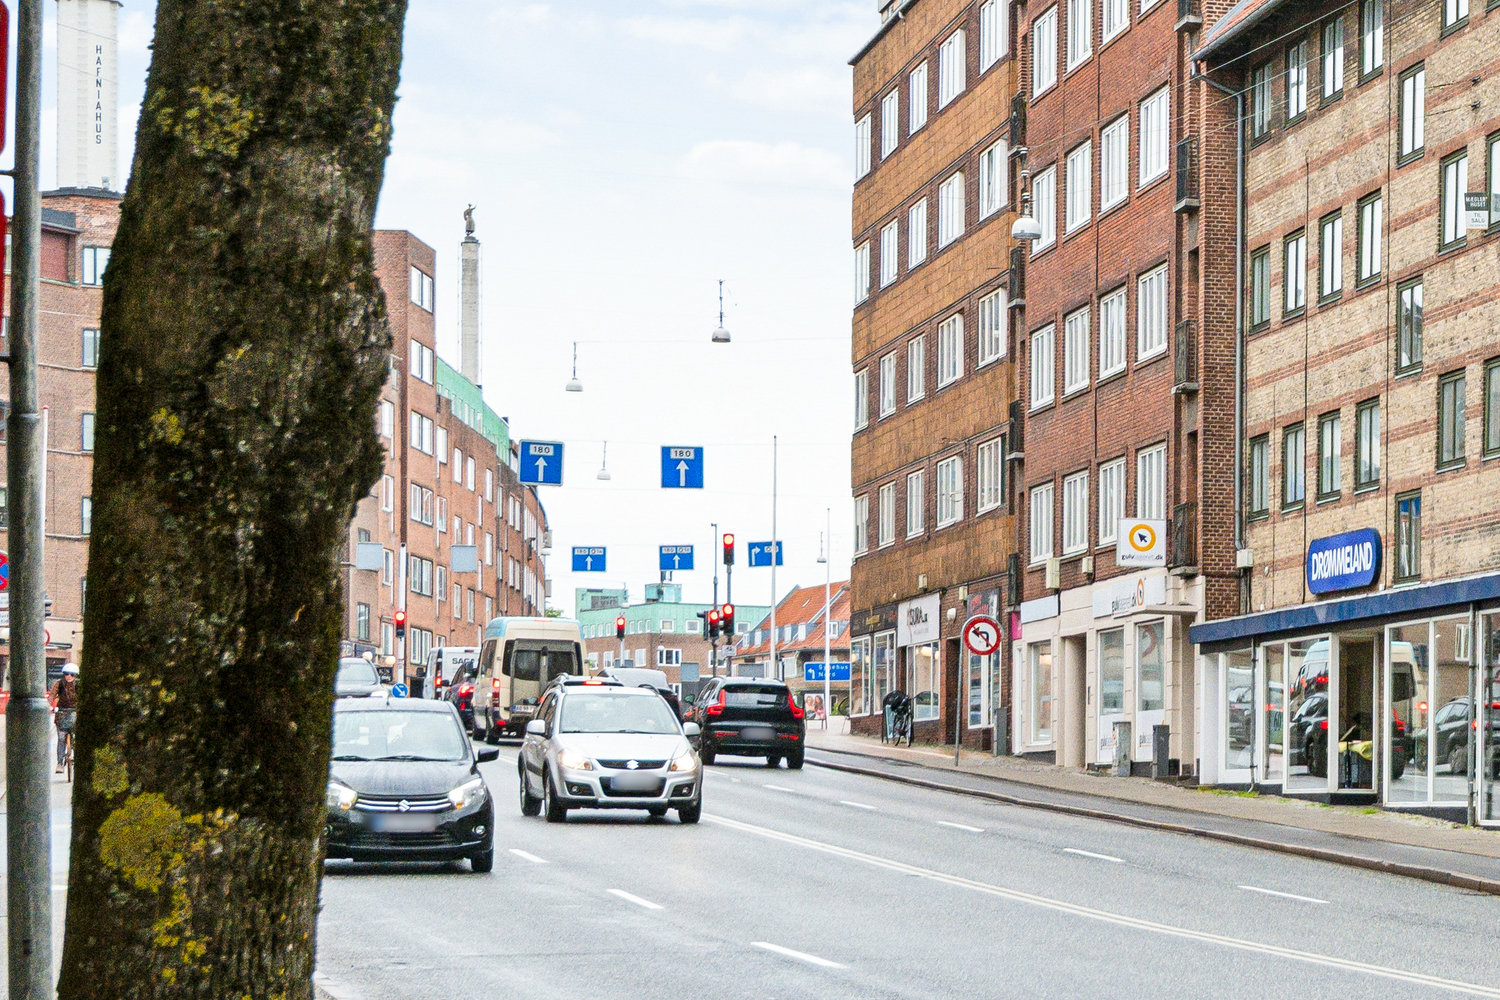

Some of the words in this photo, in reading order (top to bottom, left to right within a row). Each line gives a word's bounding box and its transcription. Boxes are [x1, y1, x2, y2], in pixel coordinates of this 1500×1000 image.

[95, 44, 103, 145] HAFNIAHUS
[532, 445, 551, 454] 180
[673, 449, 692, 458] 180
[1311, 541, 1373, 581] DRØMMELAND
